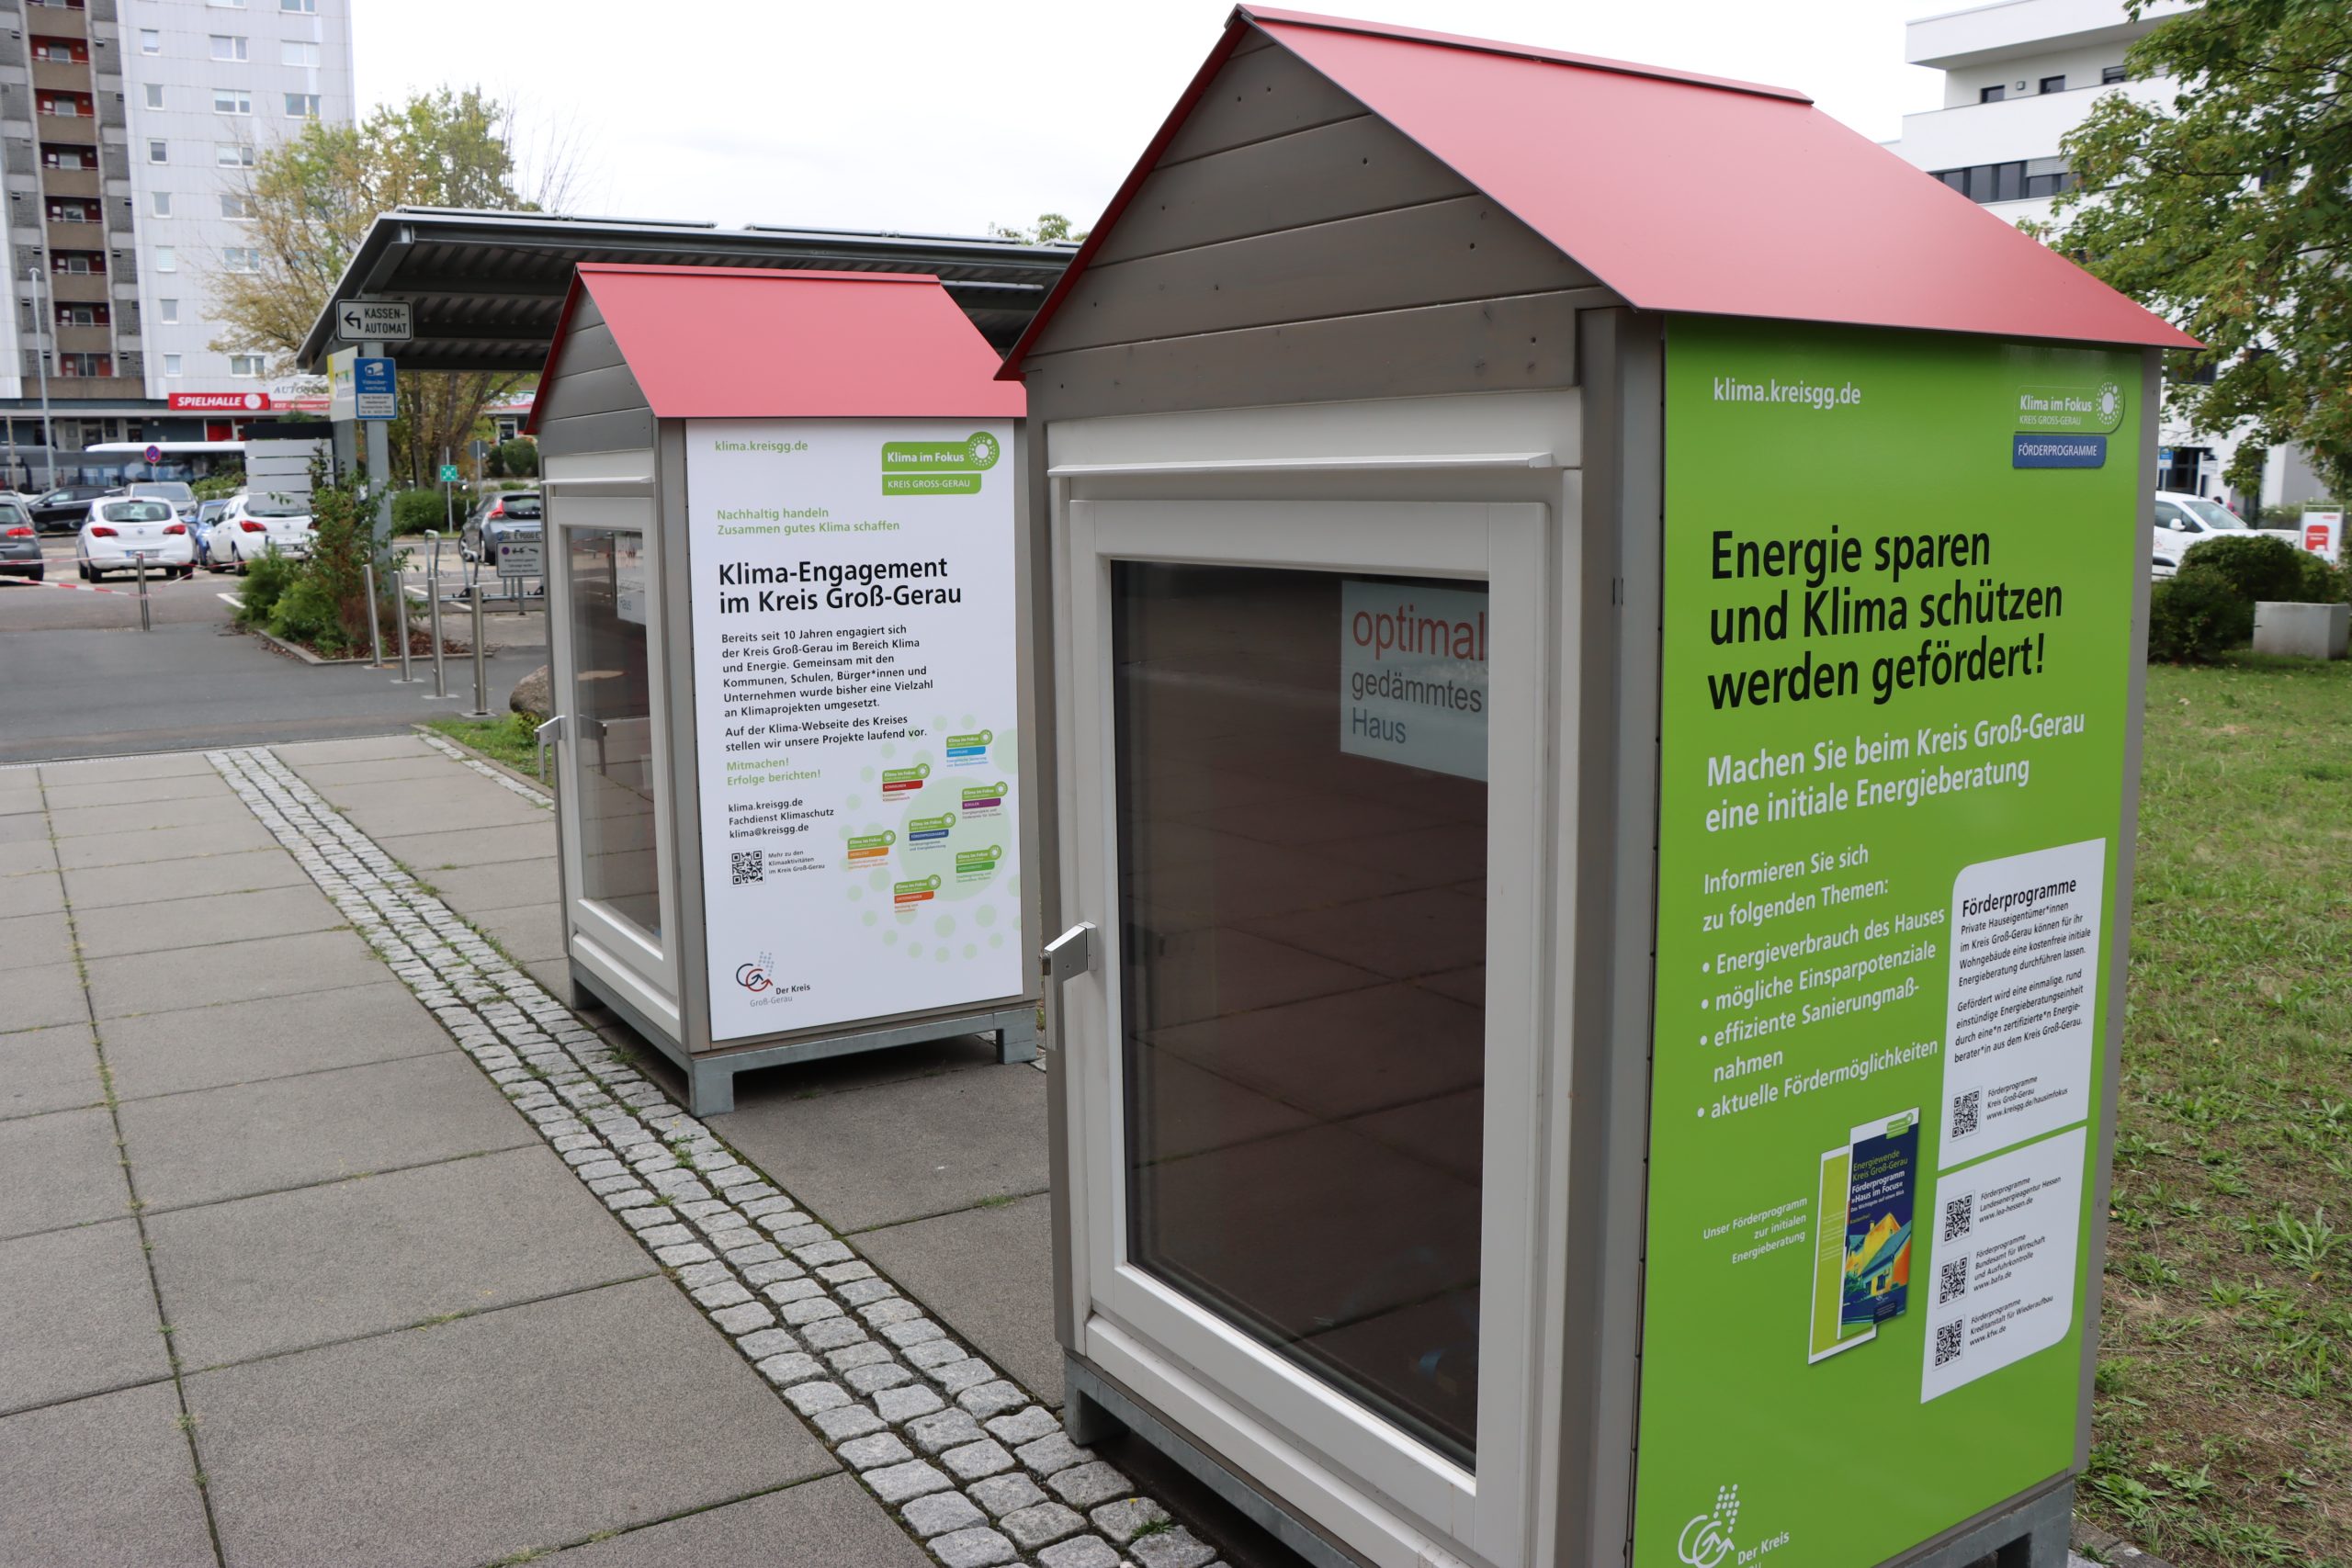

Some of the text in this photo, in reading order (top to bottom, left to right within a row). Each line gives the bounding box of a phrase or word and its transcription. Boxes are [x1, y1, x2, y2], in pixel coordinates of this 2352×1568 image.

[364, 309, 405, 319] KASSEN-
[365, 323, 406, 333] AUTOMAT
[177, 397, 242, 406] SPIELHALLE
[1713, 377, 1860, 410] klima.kreisgg.de
[2020, 395, 2092, 412] Klima im Fokus
[2019, 415, 2081, 425] KREIS GROSS-GERAU
[715, 440, 808, 455] klima.kreisgg.de
[888, 452, 917, 462] Klima
[934, 452, 964, 462] Fokus
[2018, 443, 2097, 456] FÖRDERPROGRAMME
[888, 479, 970, 488] KREIS GROSS-GERAU
[717, 507, 829, 521] Nachhaltig handeln
[718, 520, 899, 536] Zusammen gutes Klima schaffen
[1712, 525, 1989, 588] Energie sparen
[719, 558, 947, 587] Klima-Engagement
[720, 584, 961, 614] im Kreis Groß-Gerau
[1711, 578, 2062, 645] und Klima schützen
[721, 624, 906, 643] Bereits seit 10 Jahren engagiert sich
[1352, 603, 1485, 660] optimal
[722, 638, 919, 658] der Kreis Groß-Gerau im Bereich Klima
[722, 654, 894, 672] und Energie. Gemeinsam mit den
[723, 677, 786, 687] Kommunen,
[790, 672, 832, 683] Schulen,
[908, 665, 926, 675] und
[1707, 632, 2044, 709] werden gefördert!
[724, 679, 933, 702] Unternehmen wurde bisher eine Vielzahl
[1352, 670, 1482, 713] gedämmtes
[724, 698, 879, 717] an Klimaprojekten umgesetzt.
[725, 715, 908, 737] Auf der Klima-Webseite des Kreises
[1352, 707, 1407, 744] Haus
[726, 740, 760, 751] stellen
[763, 739, 781, 748] wir
[785, 738, 819, 747] unsere
[822, 732, 864, 745] Projekte
[867, 728, 905, 740] laufend
[1708, 713, 2084, 786] Machen Sie beim Kreis Groß-Gerau
[727, 757, 788, 771] Mitmachen!
[727, 769, 820, 785] Erfolge berichten!
[728, 797, 803, 812] klima.kreisgg.de
[1705, 760, 2029, 832] eine initiale Energieberatung
[729, 808, 833, 825] Fachdienst Klimaschutz
[729, 823, 808, 838] klima@kreisgg.de
[1704, 843, 1868, 894] Informieren Sie sich
[1702, 879, 1888, 931] zu folgenden Themen:
[1962, 879, 2076, 917] Förderprogramme
[1716, 908, 1944, 974] Energieverbrauch des Hauses
[1960, 913, 2083, 952] im Kreis Groß-Gerau können für ihr
[1961, 922, 1986, 935] Private
[1959, 928, 2091, 969] Wohngebäude eine kostenfreie initiale
[1715, 940, 1936, 1010] mögliche Einsparpotenziale
[1959, 946, 2086, 987] Energieberatung durchführen lassen.
[750, 996, 792, 1007] Groß-Gerau
[1957, 968, 2082, 1011] Gefördert wird eine einmalige, rund
[1714, 976, 1918, 1046] effiziente Sanierungmaß-
[1956, 985, 2083, 1029] einstündige Energieberatungseinheit
[1955, 1032, 1975, 1046] durch
[2052, 1003, 2080, 1016] Energie-
[1993, 1041, 2005, 1051] aus
[2007, 1035, 2021, 1046] dem
[2023, 1029, 2041, 1041] Kreis
[2042, 1018, 2082, 1035] Groß-Gerau.
[1711, 1041, 1938, 1118] aktuelle Fördermöglichkeiten
[1713, 1051, 1782, 1082] nahmen
[1987, 1089, 2034, 1108] Kreis Groß-Gerau
[1988, 1077, 2038, 1097] Förderprogramme
[1703, 1198, 1807, 1239] Unser Förderprogramm
[1754, 1214, 1806, 1239] zur initialen
[1732, 1231, 1805, 1264] Energieberatung
[1738, 1531, 1790, 1565] Der Kreis
